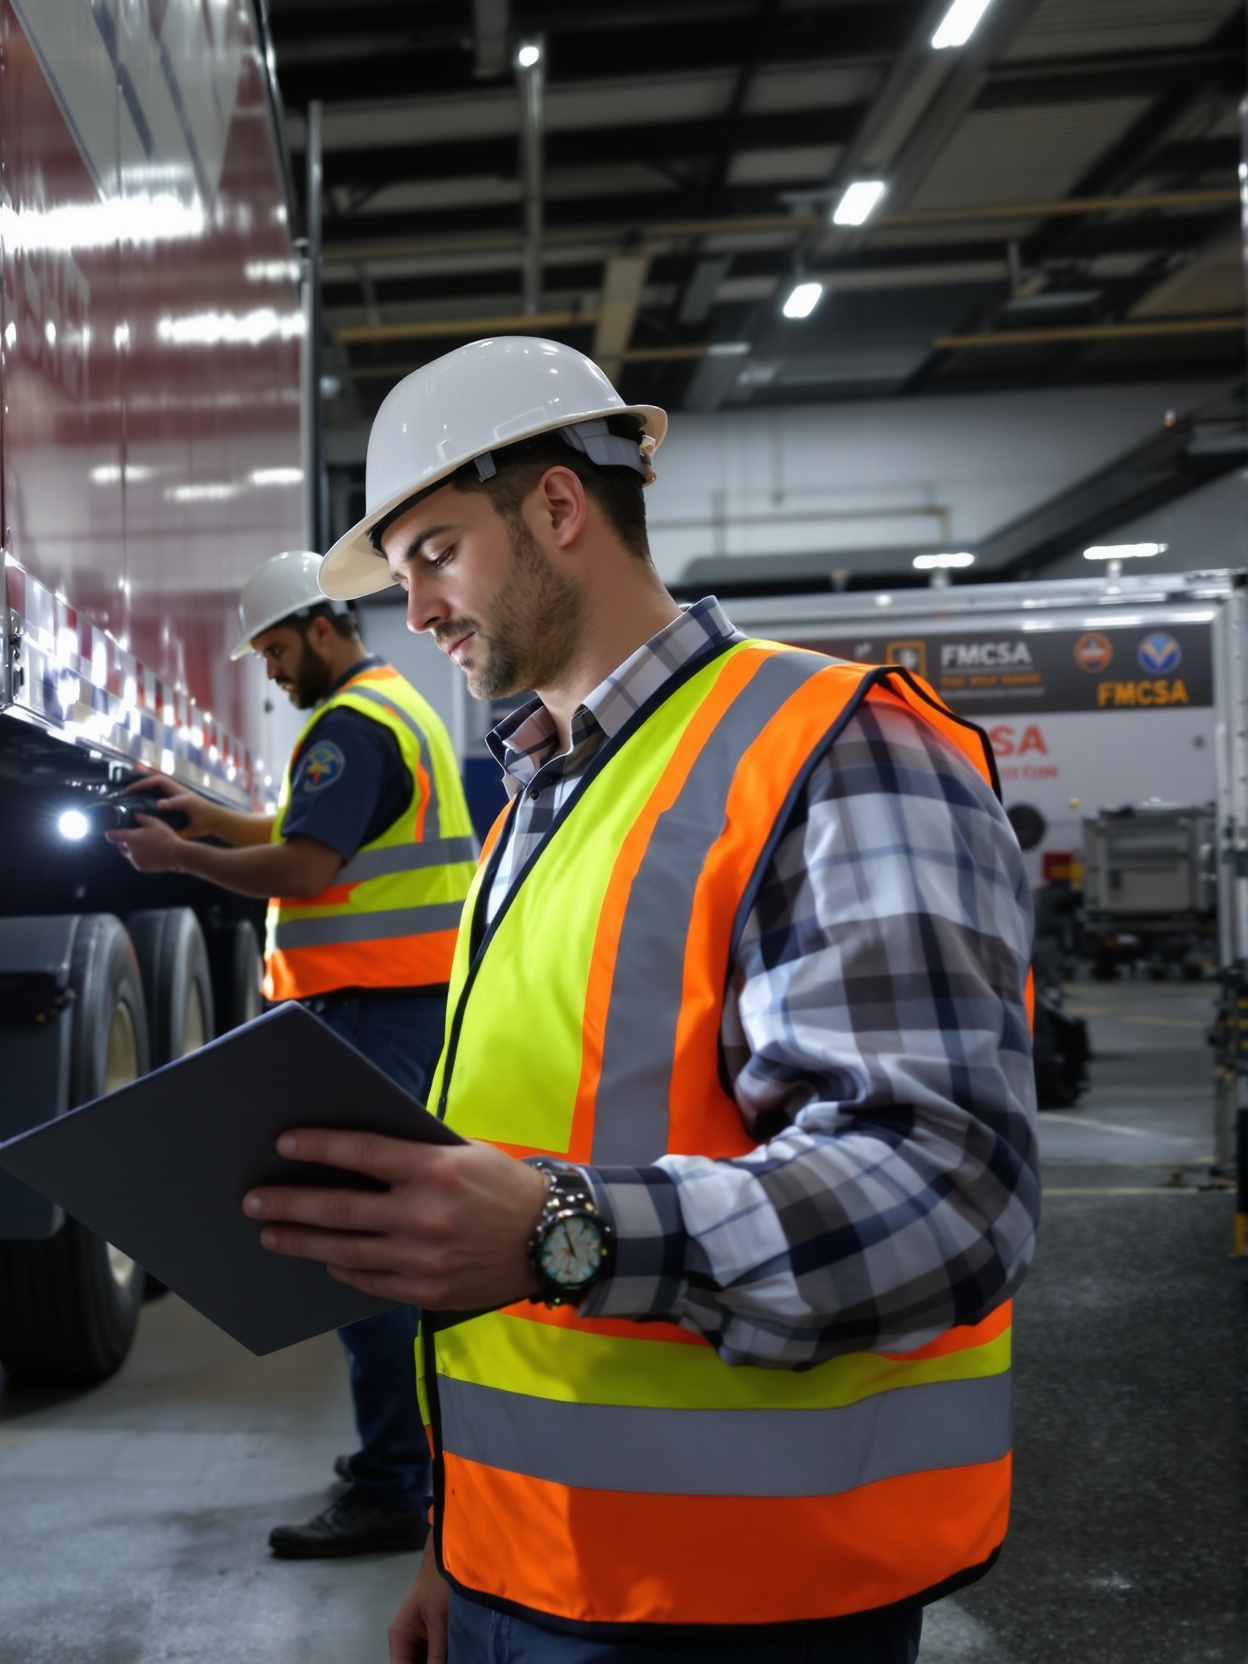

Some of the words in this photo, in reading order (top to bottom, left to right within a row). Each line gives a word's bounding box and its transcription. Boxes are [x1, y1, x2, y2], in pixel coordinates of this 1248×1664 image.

[940, 641, 1033, 668] FMCSA
[1097, 679, 1189, 707] FMCSA
[989, 725, 1049, 757] SA
